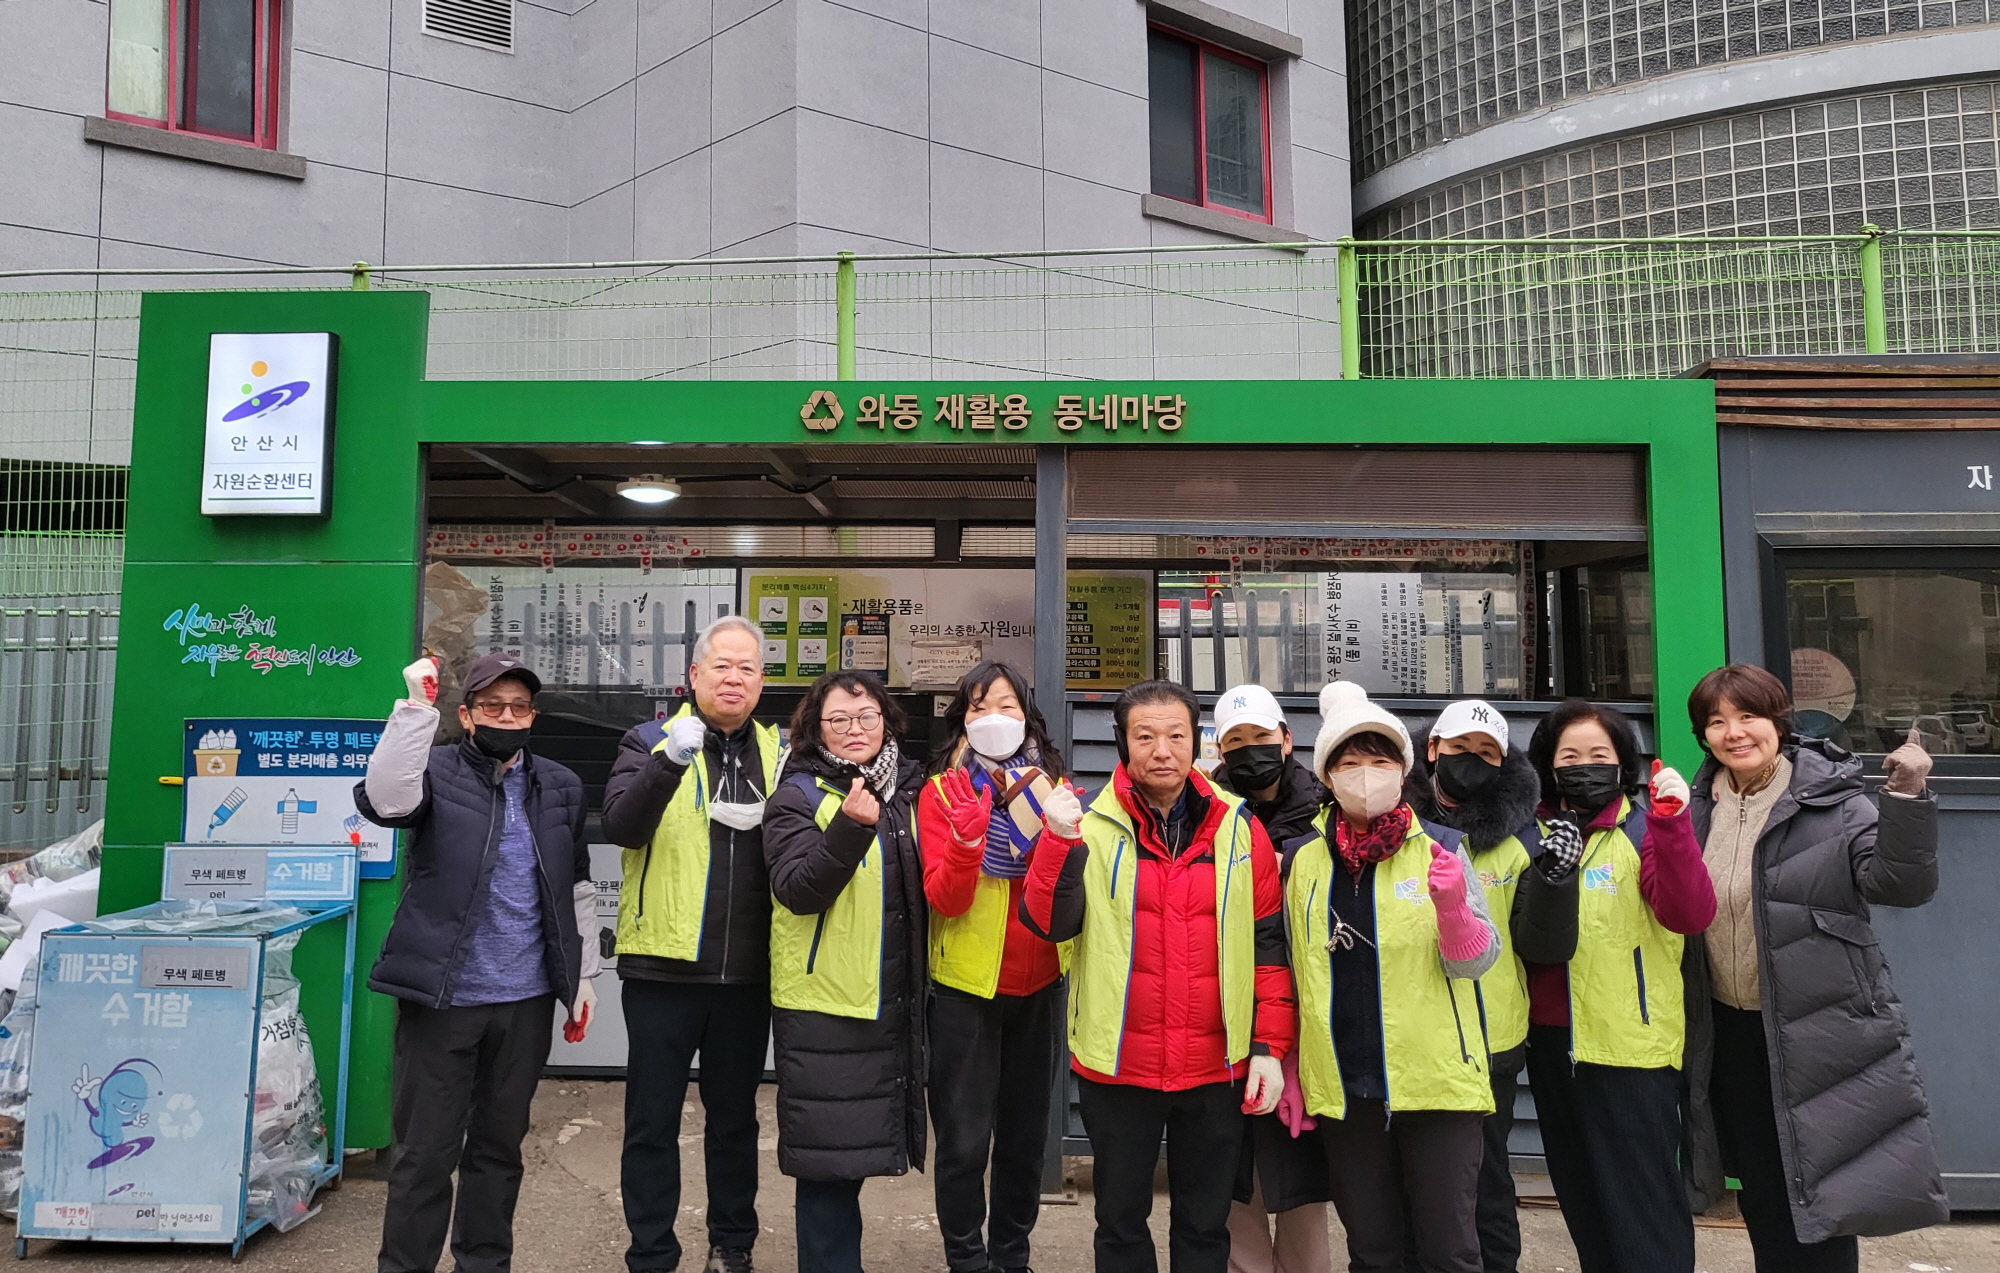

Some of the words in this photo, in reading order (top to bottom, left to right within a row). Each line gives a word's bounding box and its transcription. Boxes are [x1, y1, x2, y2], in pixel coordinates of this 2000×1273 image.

[856, 393, 923, 431] 와동
[934, 393, 1033, 431] 재활용
[1053, 393, 1186, 431] 동네마당
[212, 473, 313, 490] 자원순환센터
[908, 624, 941, 637] 우리의
[944, 624, 976, 637] 소중한
[979, 620, 1035, 638] 자원입니
[181, 643, 243, 677] 자유로운
[244, 642, 317, 676] 혁신도시
[318, 646, 362, 667] 안산
[1471, 706, 1489, 723] NY
[309, 731, 339, 749] 투명
[257, 753, 284, 768] 별도
[287, 753, 339, 768] 분리배출
[342, 753, 373, 768] 의무
[190, 869, 212, 880] 무색
[215, 869, 247, 880] 페트병
[273, 862, 334, 881] 수거함
[58, 952, 138, 985] 깨끗한
[163, 968, 188, 981] 무색
[191, 968, 227, 982] 페트병
[136, 1207, 156, 1219] pet
